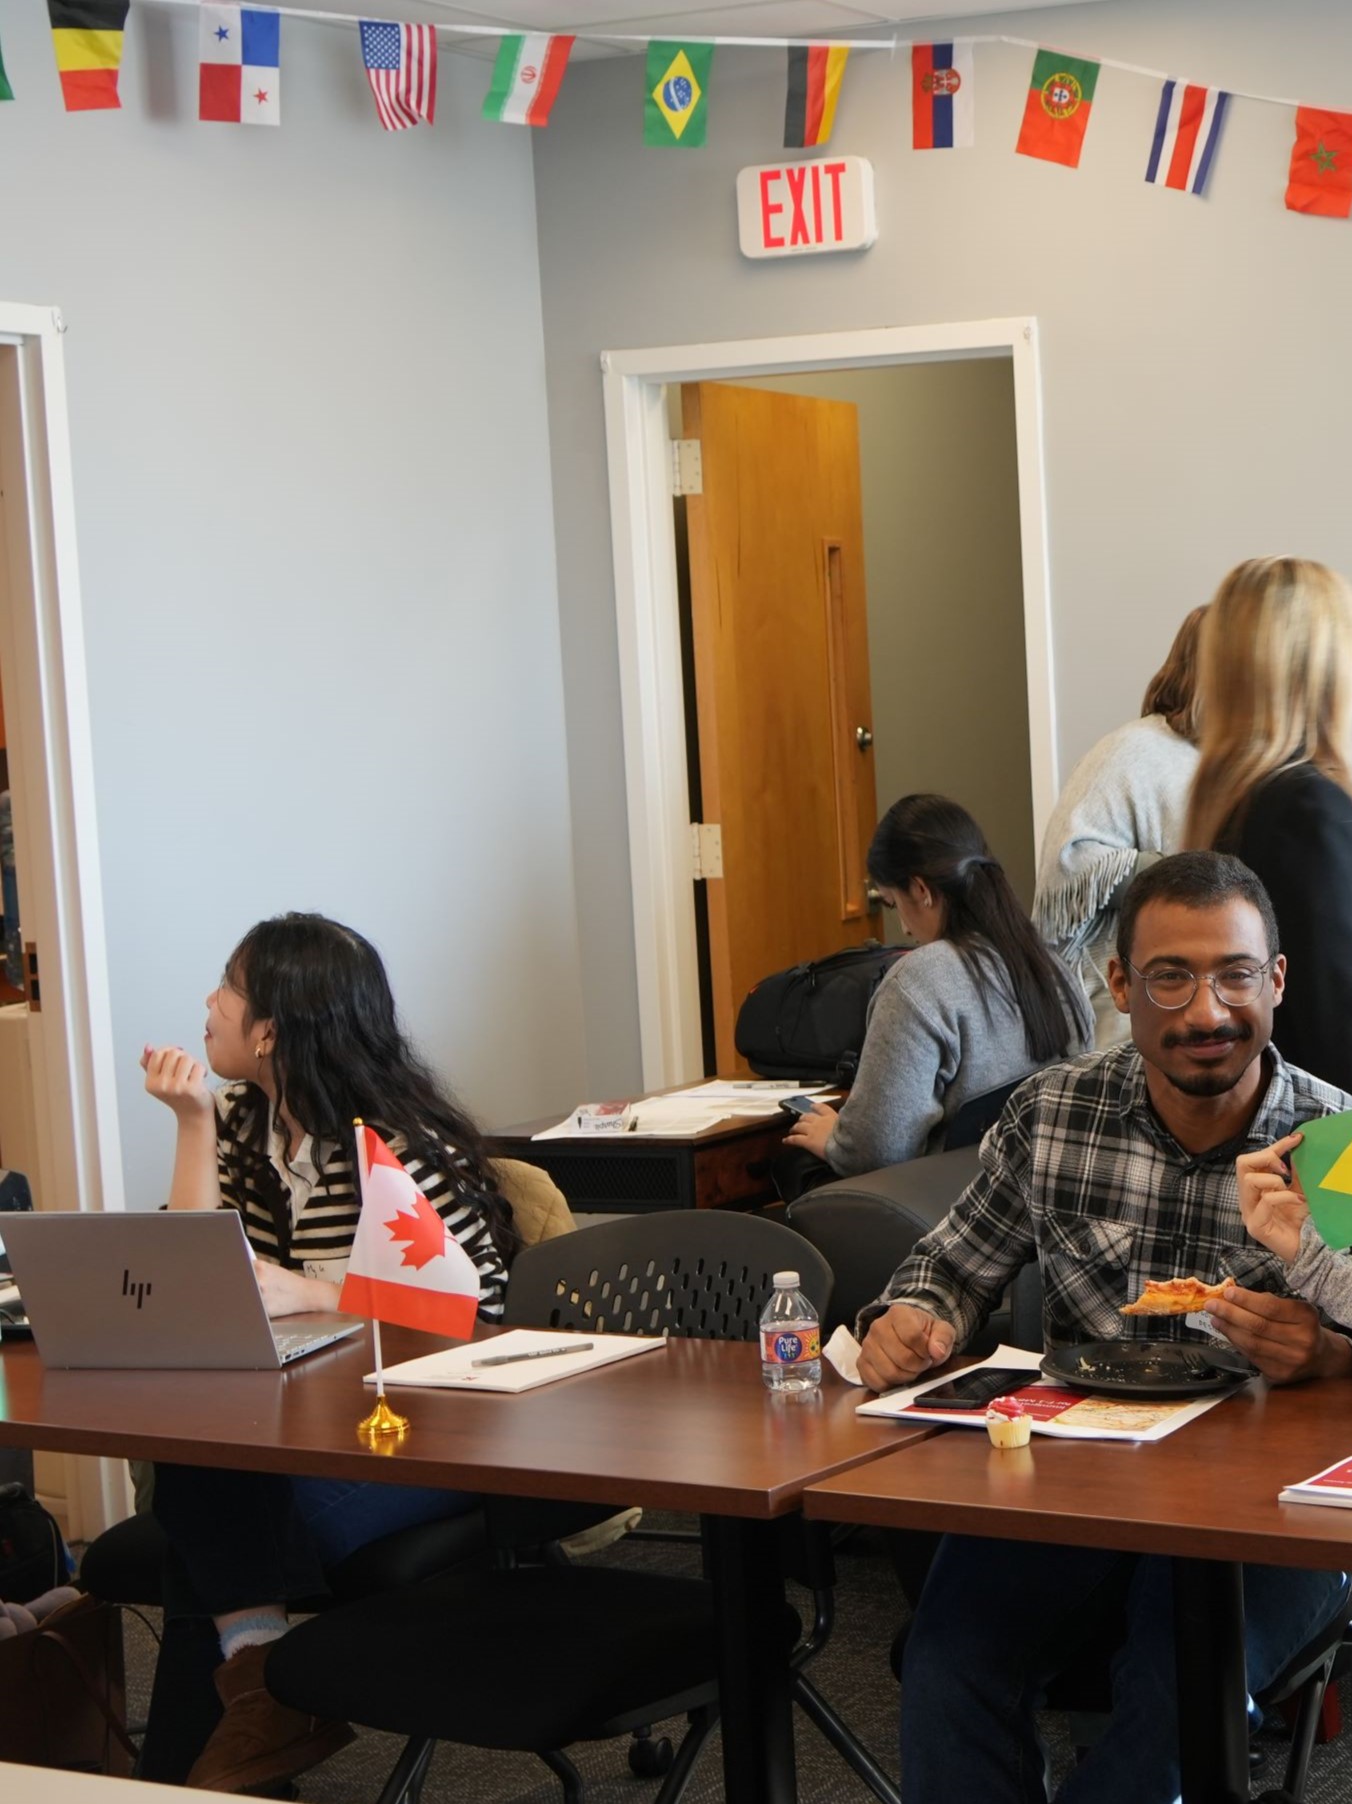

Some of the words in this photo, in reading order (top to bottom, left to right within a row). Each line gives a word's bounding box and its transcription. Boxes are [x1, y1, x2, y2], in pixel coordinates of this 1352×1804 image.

[759, 163, 846, 249] EXIT
[122, 1269, 152, 1309] hp
[778, 1336, 798, 1346] Pure
[781, 1343, 797, 1353] Life
